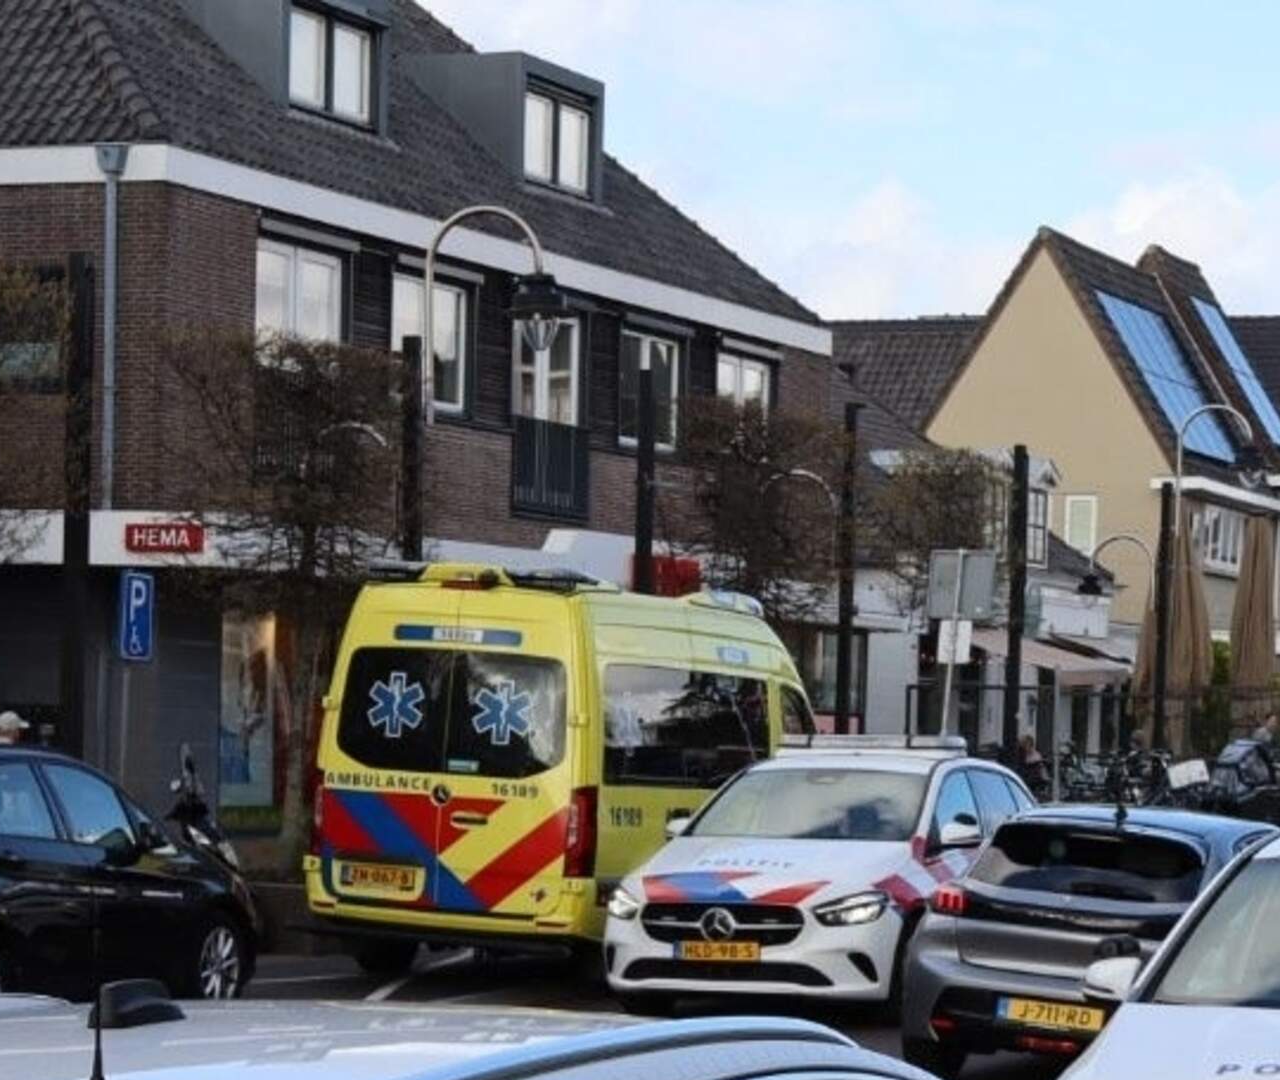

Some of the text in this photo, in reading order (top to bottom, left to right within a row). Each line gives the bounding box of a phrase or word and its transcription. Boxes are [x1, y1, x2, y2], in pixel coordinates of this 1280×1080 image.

[133, 527, 191, 547] HEMA
[130, 579, 146, 623] P
[326, 771, 431, 791] AMBULANCE
[1020, 1002, 1091, 1025] J-711-RD
